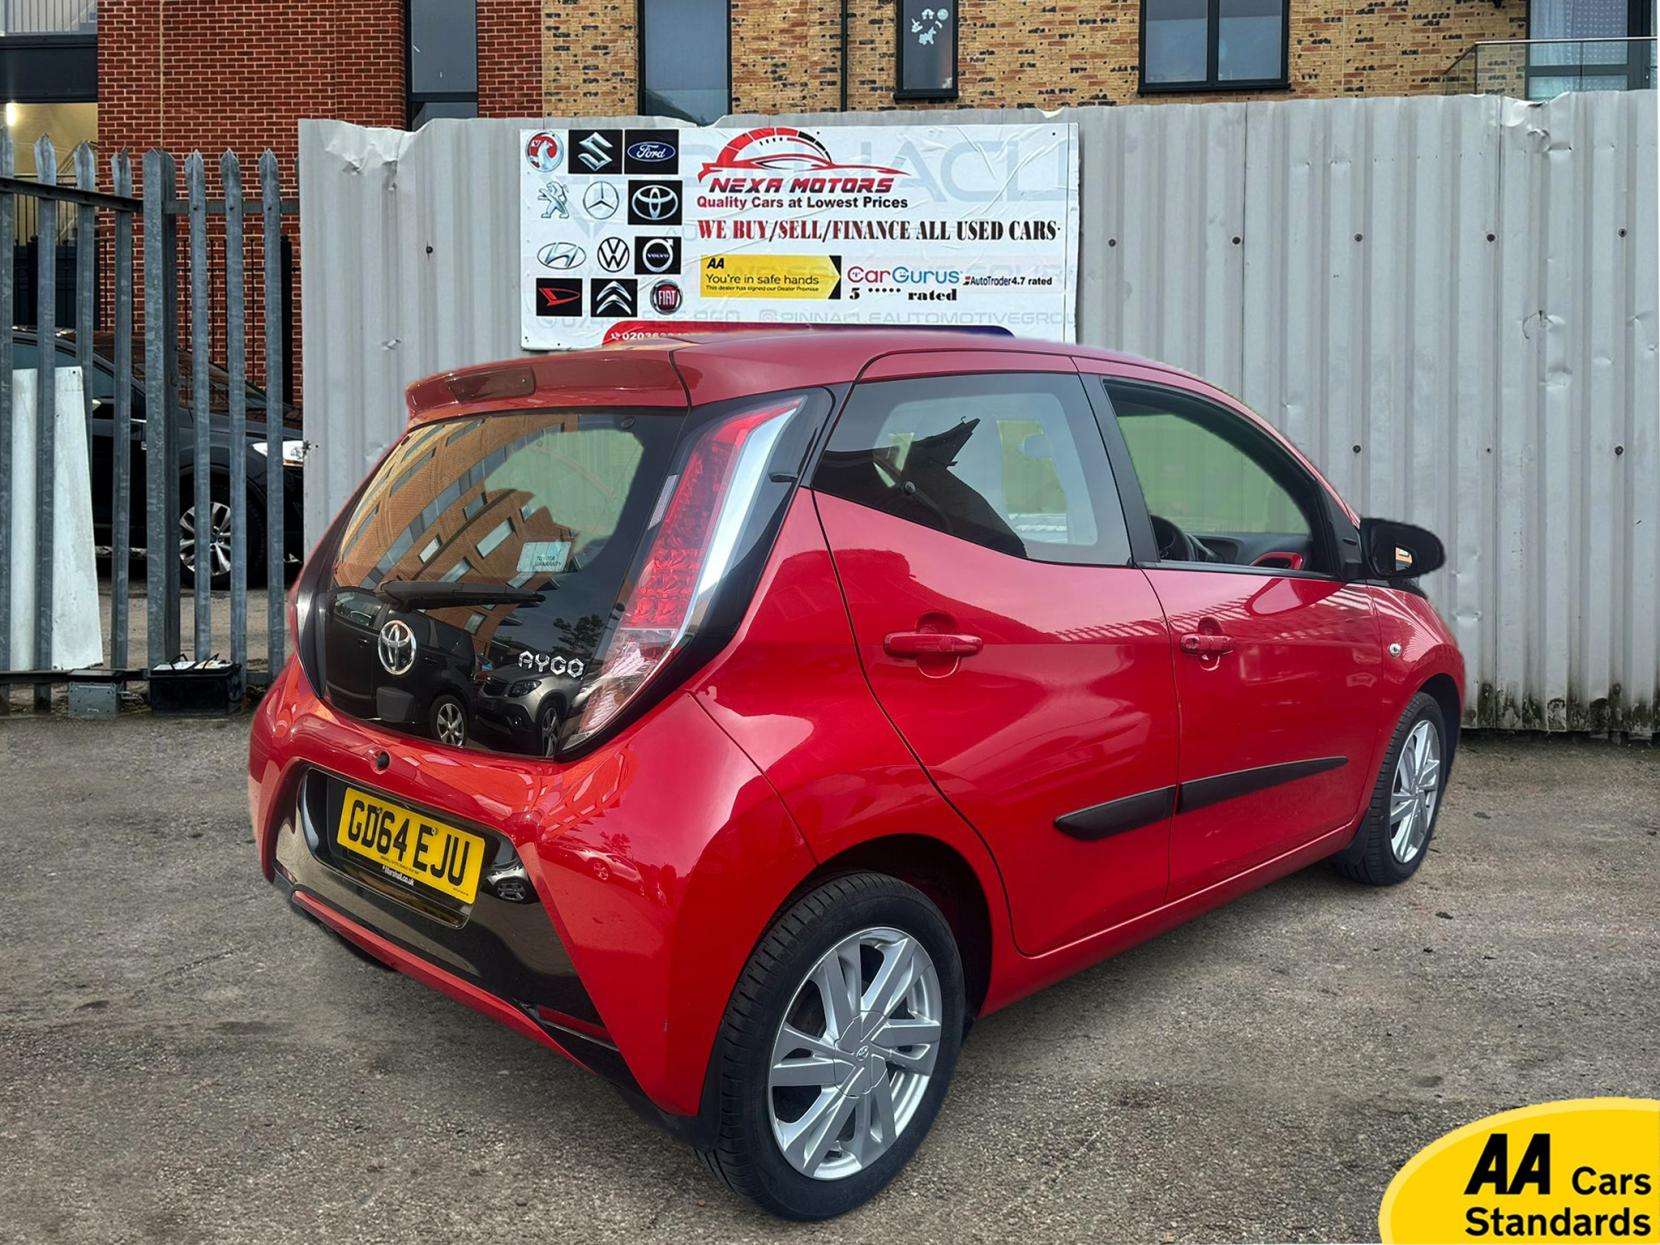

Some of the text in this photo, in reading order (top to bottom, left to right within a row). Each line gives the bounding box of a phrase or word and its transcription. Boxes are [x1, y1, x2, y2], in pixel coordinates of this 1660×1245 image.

[636, 144, 668, 159] Ford
[709, 177, 894, 194] NEXA MOTORS
[697, 195, 908, 211] Quality Cars at Lowest Prices
[697, 219, 1057, 243] WE BUY/SELL/FINANCE ALL USED CARS
[707, 257, 725, 269] AA
[705, 273, 820, 285] You're in safe hands
[847, 265, 960, 284] CarGurus
[1027, 276, 1053, 286] rated
[658, 290, 676, 306] FIAT
[849, 287, 958, 301] 5 rated
[518, 650, 585, 679] AYGO
[347, 799, 471, 887] GD64 EJU
